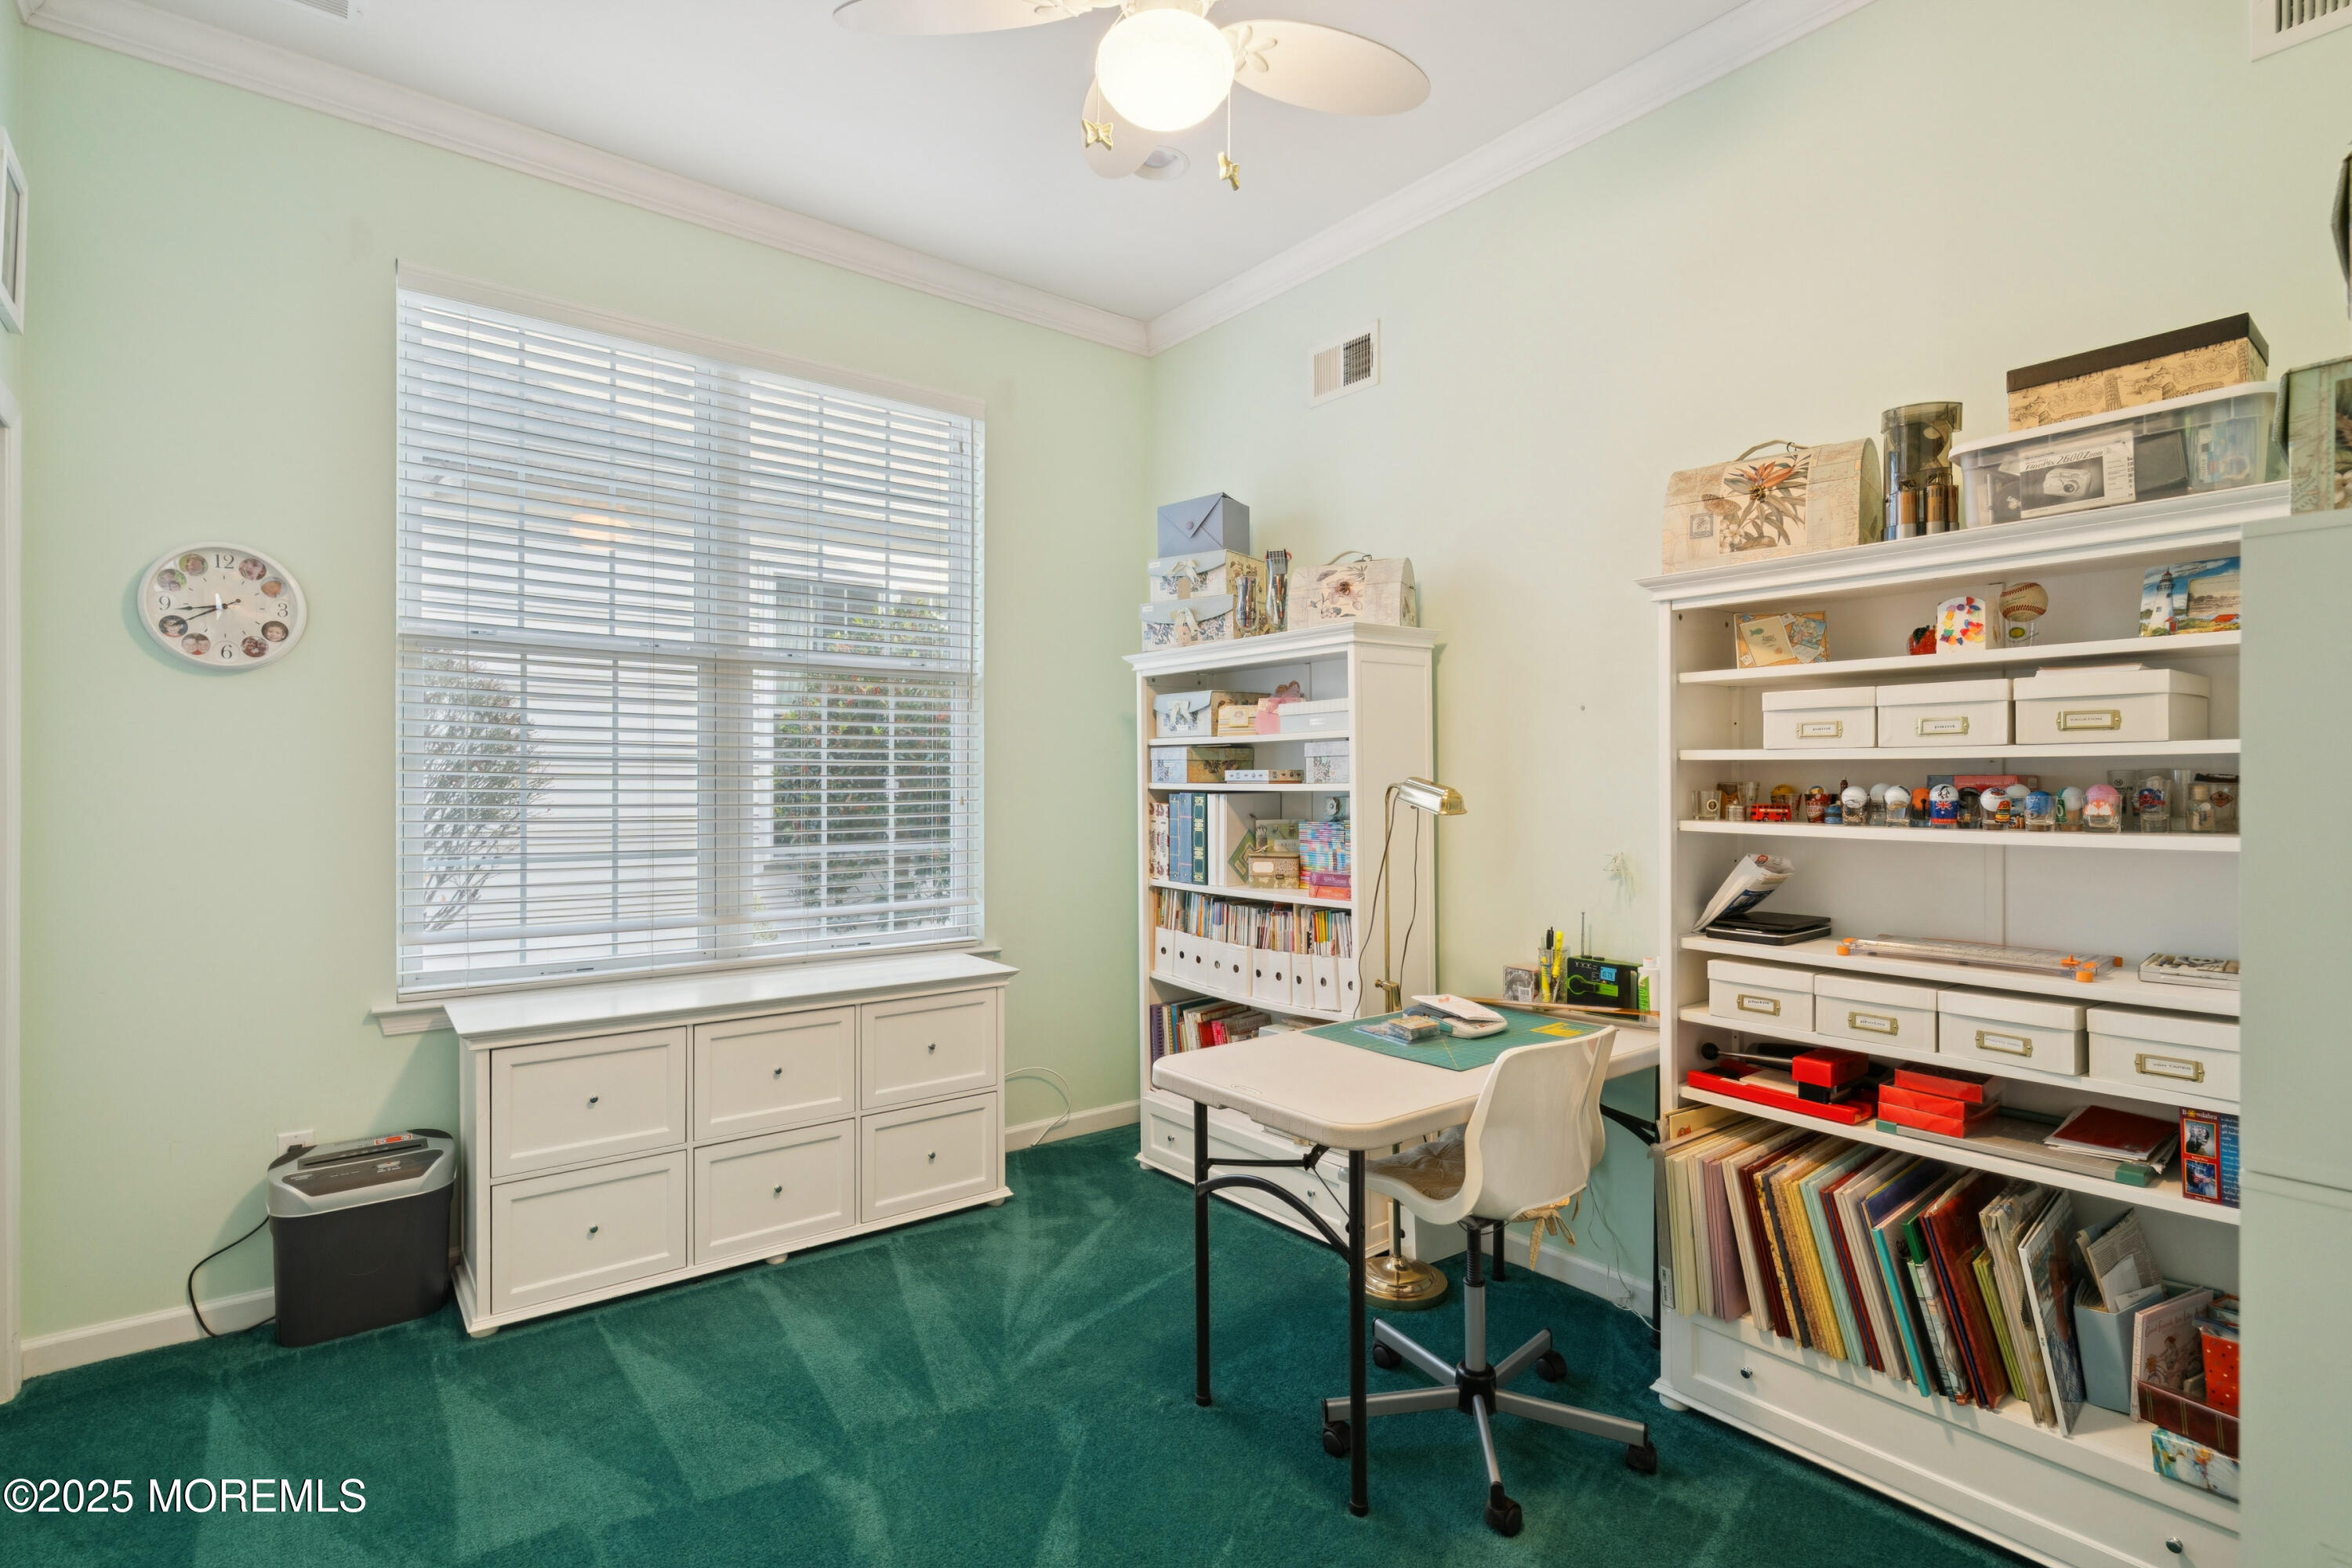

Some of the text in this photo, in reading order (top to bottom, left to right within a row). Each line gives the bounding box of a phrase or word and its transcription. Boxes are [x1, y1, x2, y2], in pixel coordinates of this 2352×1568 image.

[2025, 459, 2055, 470] FinePix
[213, 554, 234, 569] 12
[158, 595, 172, 611] 9
[276, 602, 289, 618] 3
[220, 644, 233, 659] 6
